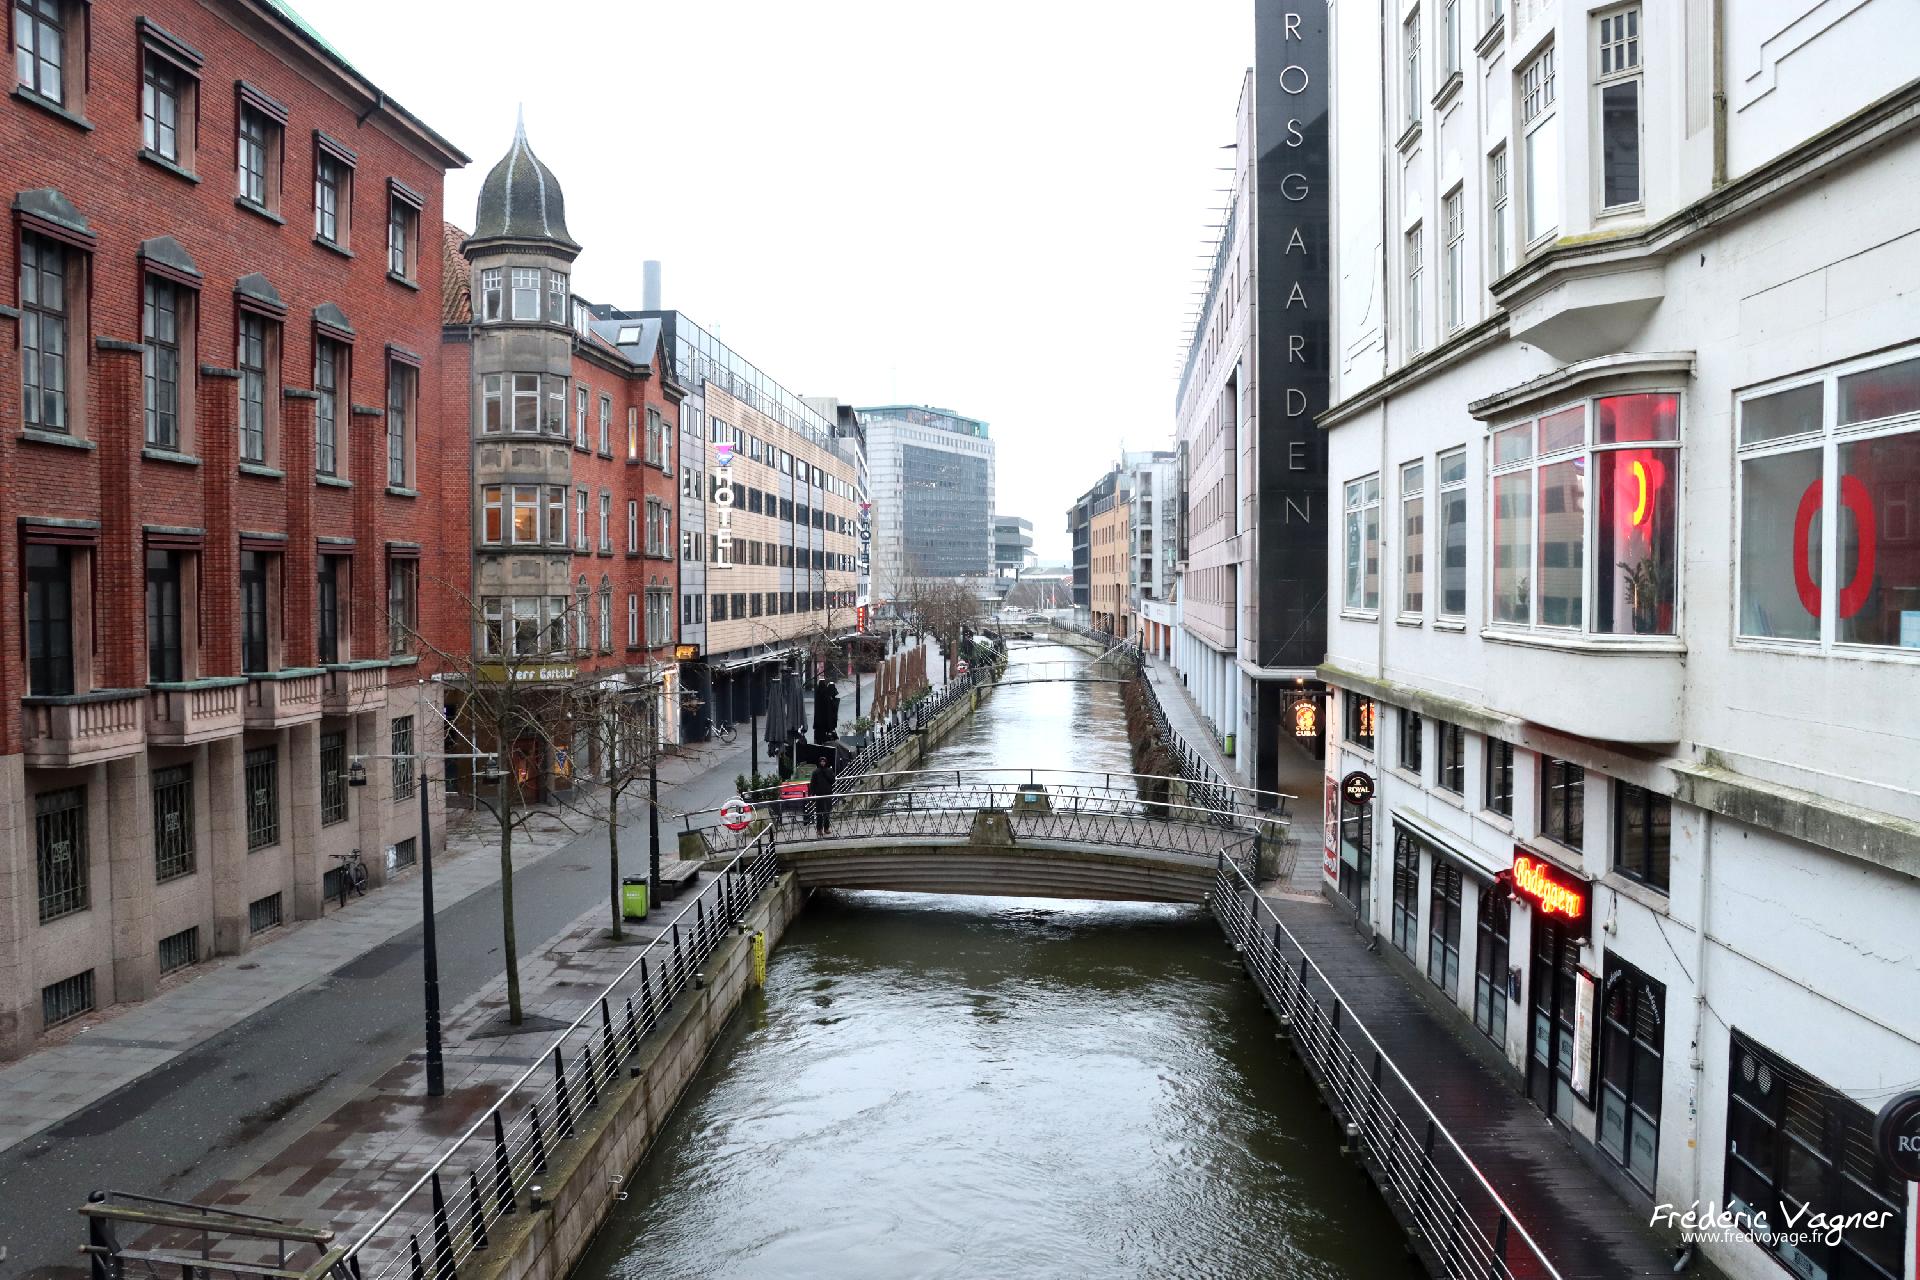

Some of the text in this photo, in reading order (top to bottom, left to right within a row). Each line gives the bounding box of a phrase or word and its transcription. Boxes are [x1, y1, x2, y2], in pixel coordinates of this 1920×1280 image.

[1279, 12, 1311, 525] ROSGAARDEN
[714, 466, 734, 568] HOTEL
[860, 519, 872, 575] HOTEL
